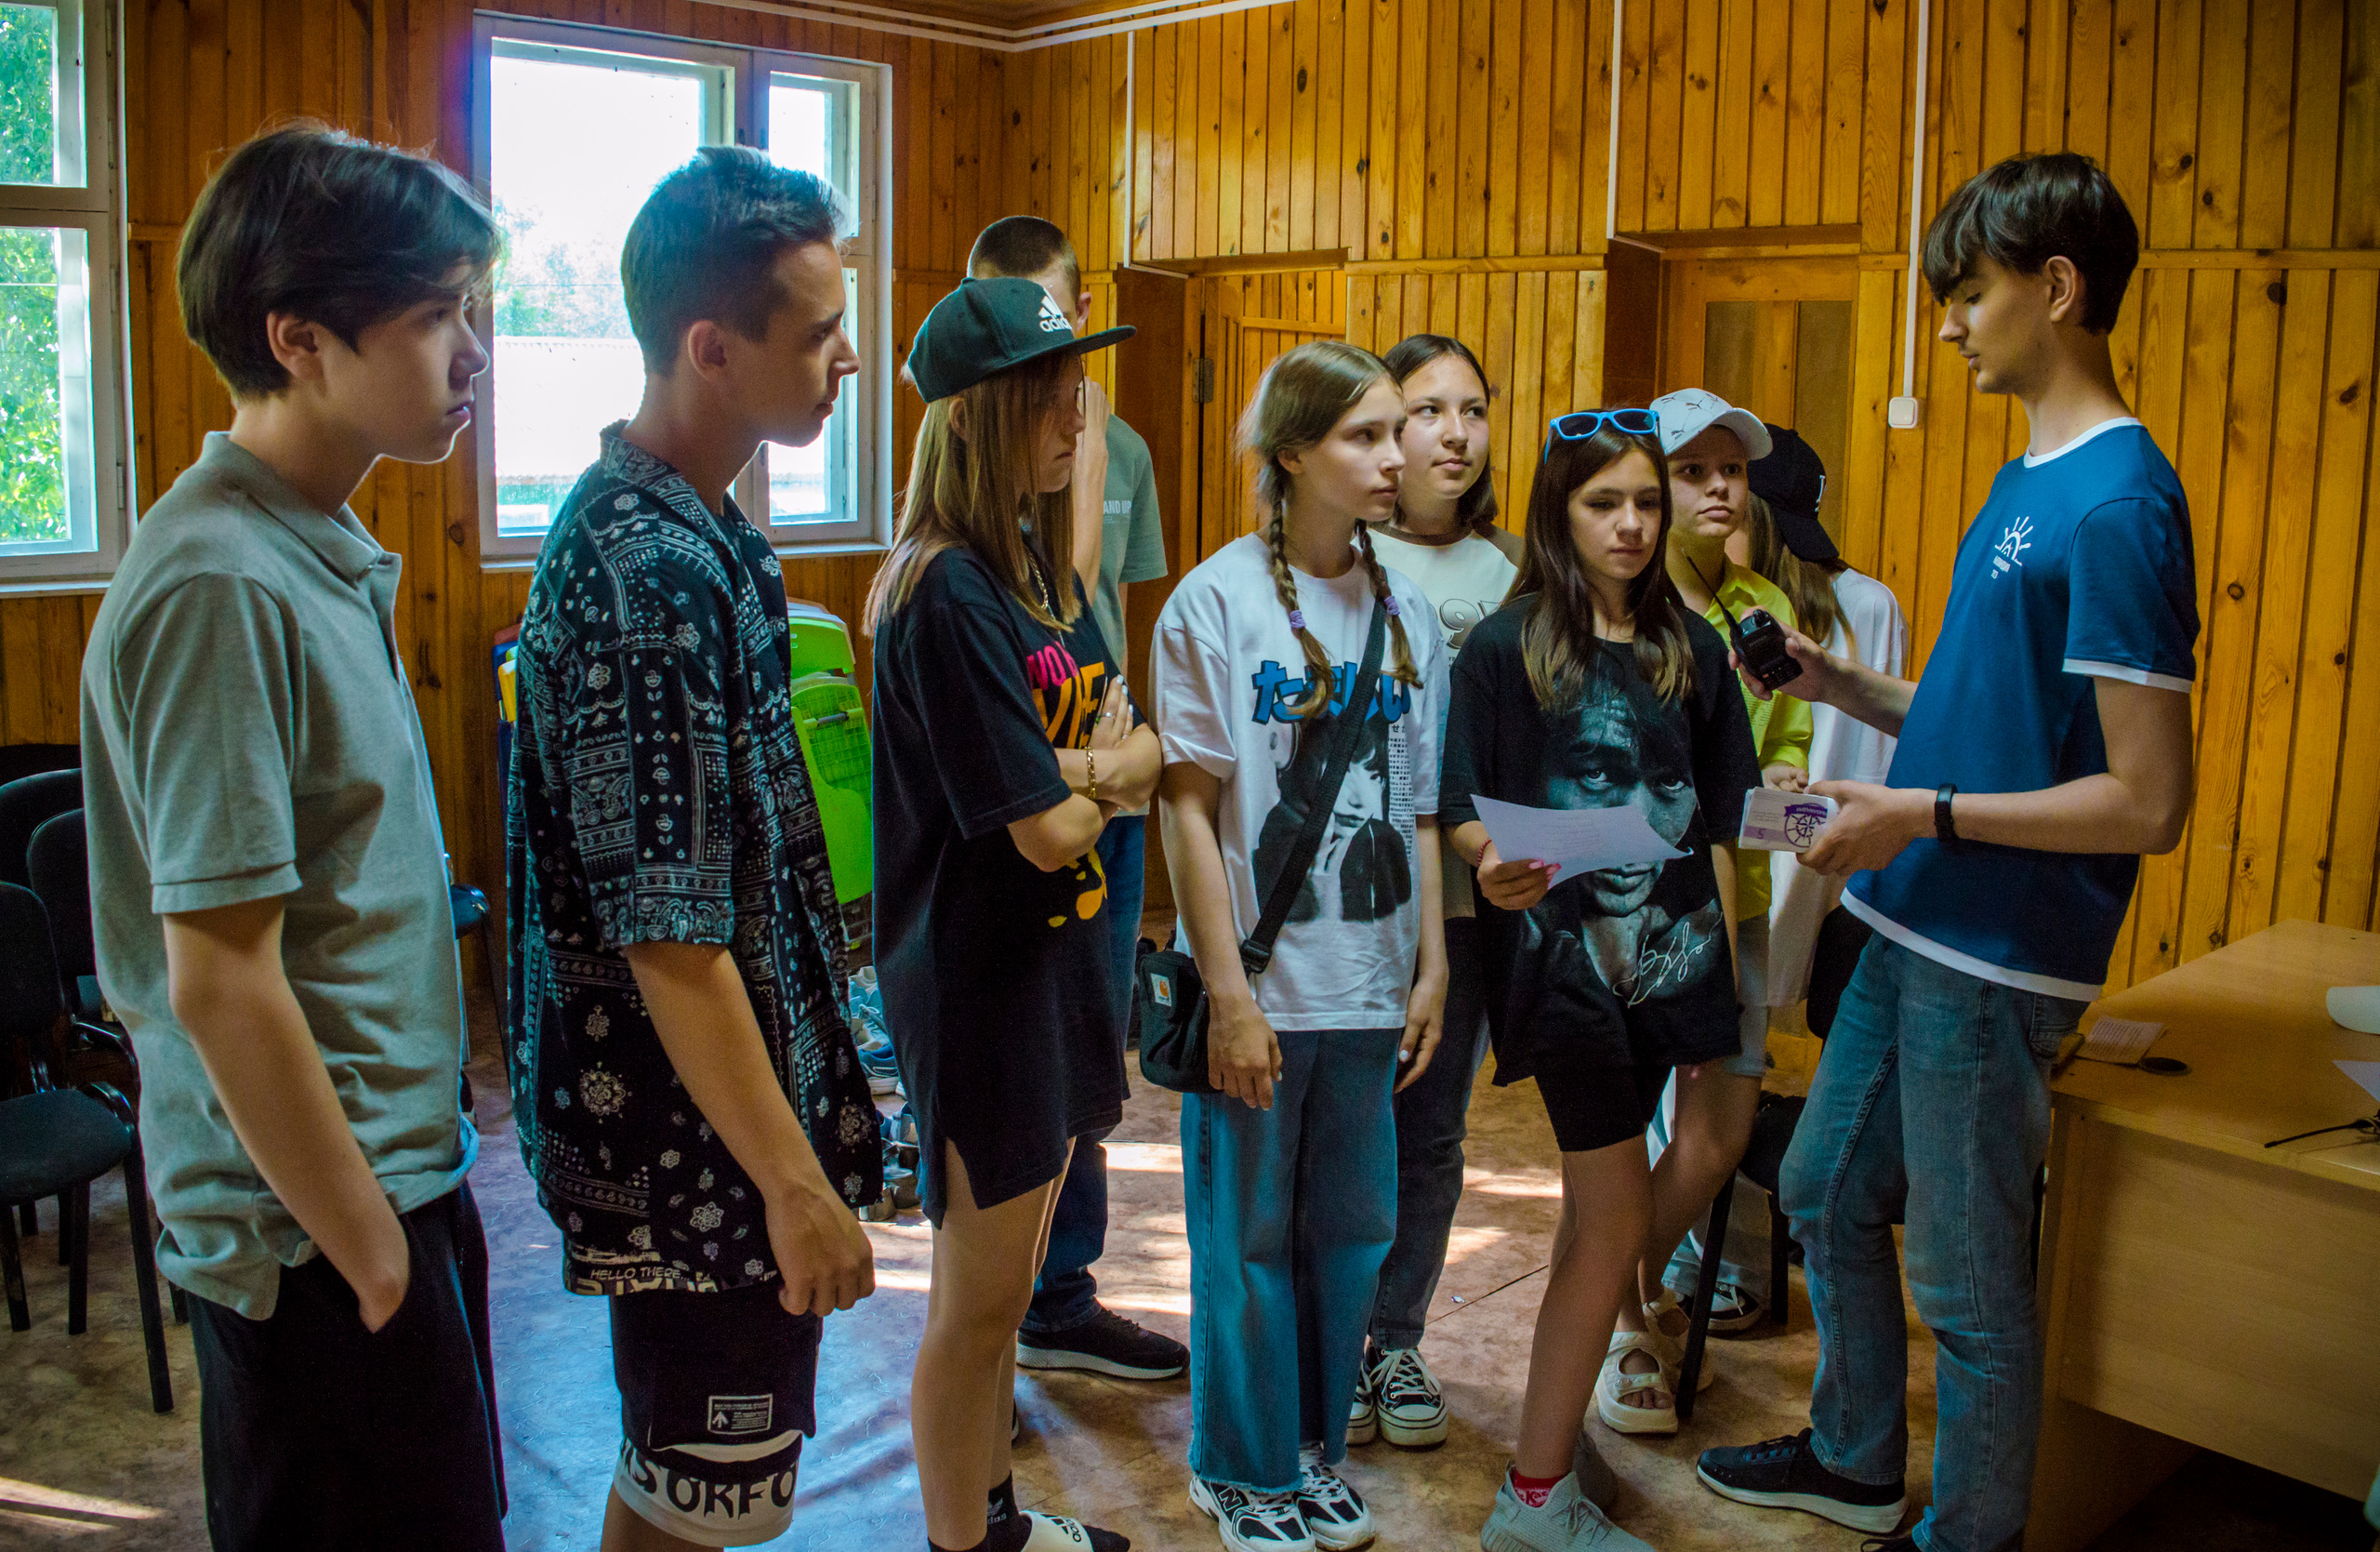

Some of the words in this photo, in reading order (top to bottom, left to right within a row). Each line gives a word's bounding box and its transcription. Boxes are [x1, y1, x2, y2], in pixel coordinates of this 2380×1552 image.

[1038, 314, 1073, 333] adid
[1121, 499, 1132, 514] UP
[589, 1267, 637, 1280] HELLO
[1218, 1487, 1243, 1512] N
